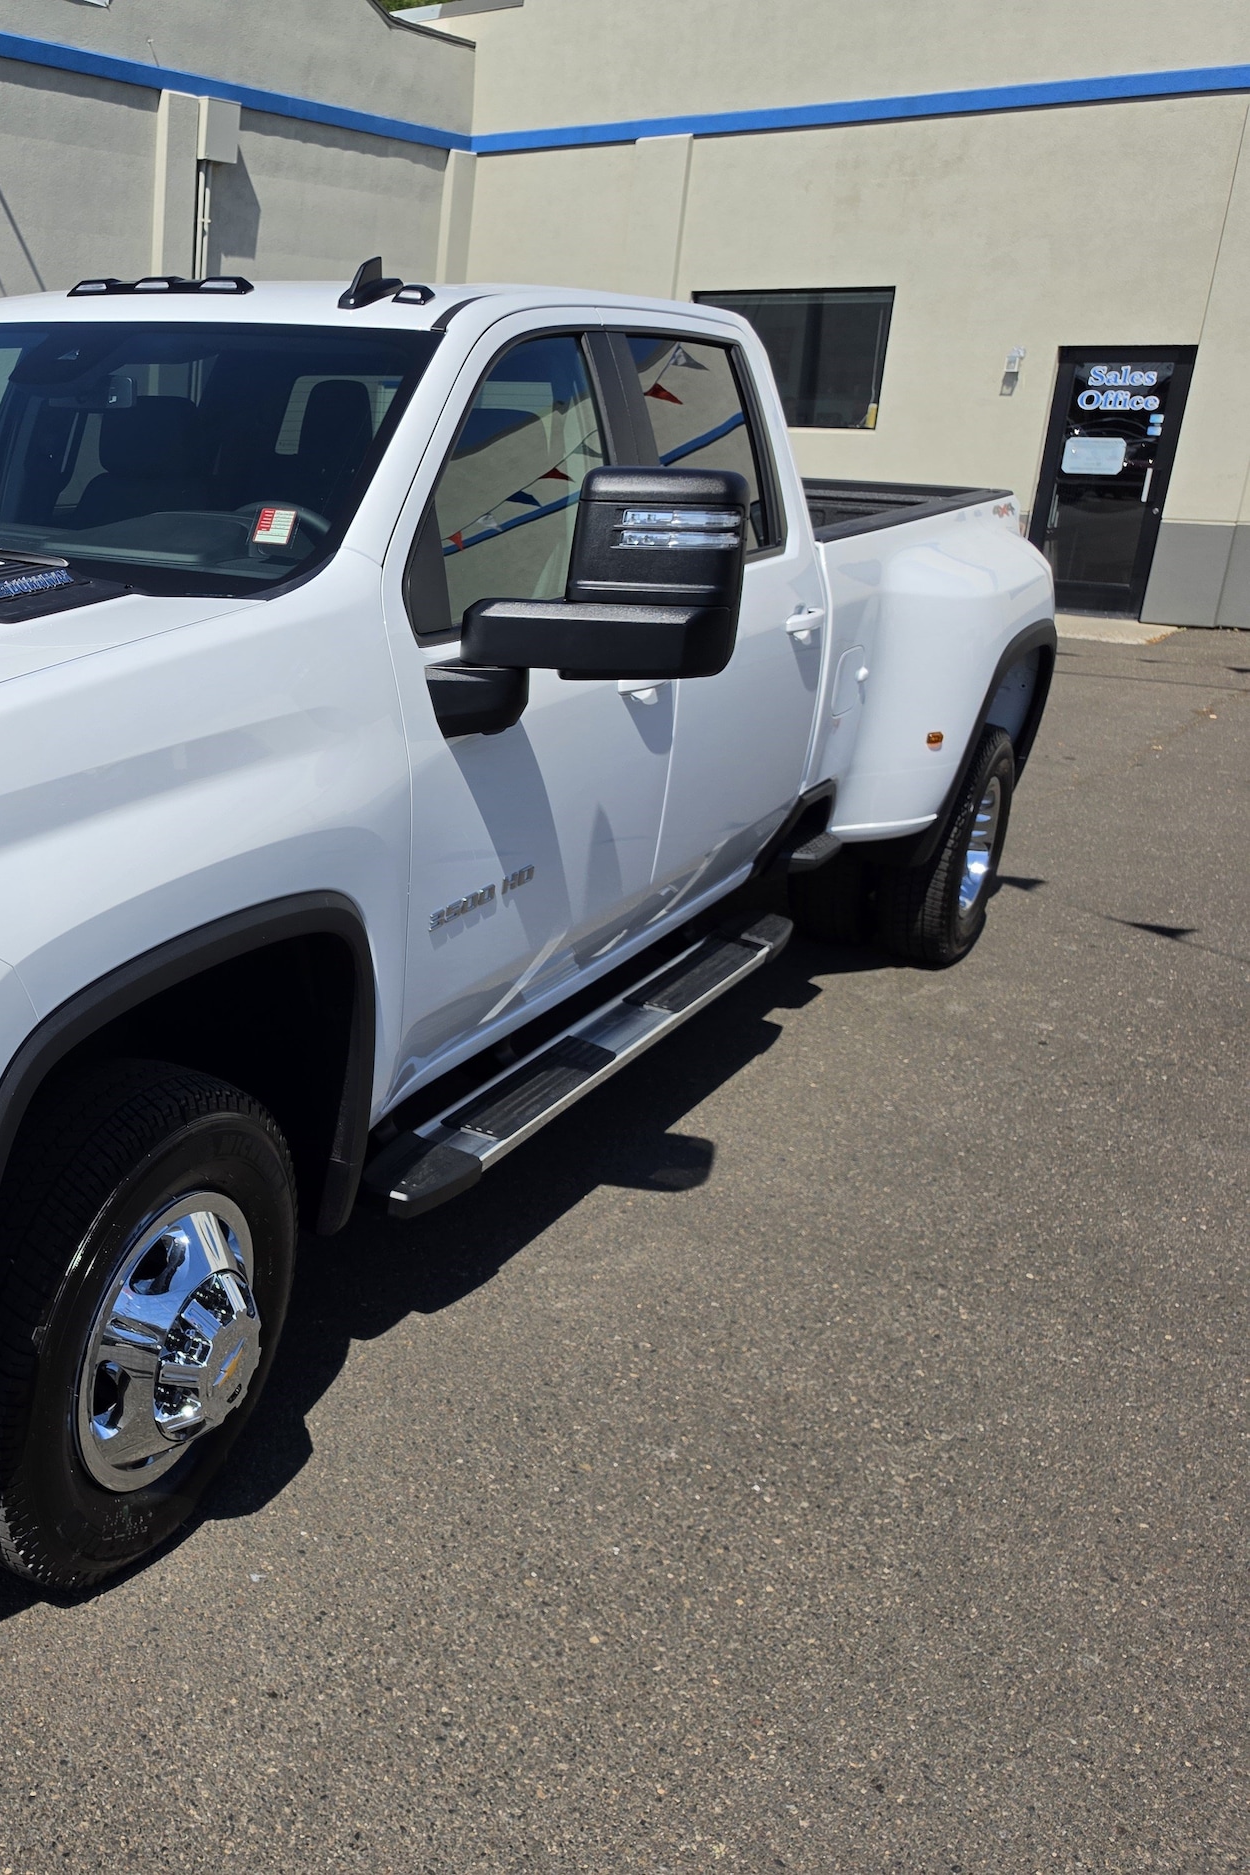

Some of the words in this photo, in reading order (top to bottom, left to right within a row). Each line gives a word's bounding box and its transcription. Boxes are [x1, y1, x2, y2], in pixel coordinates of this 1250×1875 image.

[1088, 365, 1158, 387] Sales
[1077, 389, 1160, 411] Office
[428, 884, 496, 932] 3500
[502, 864, 535, 895] HD
